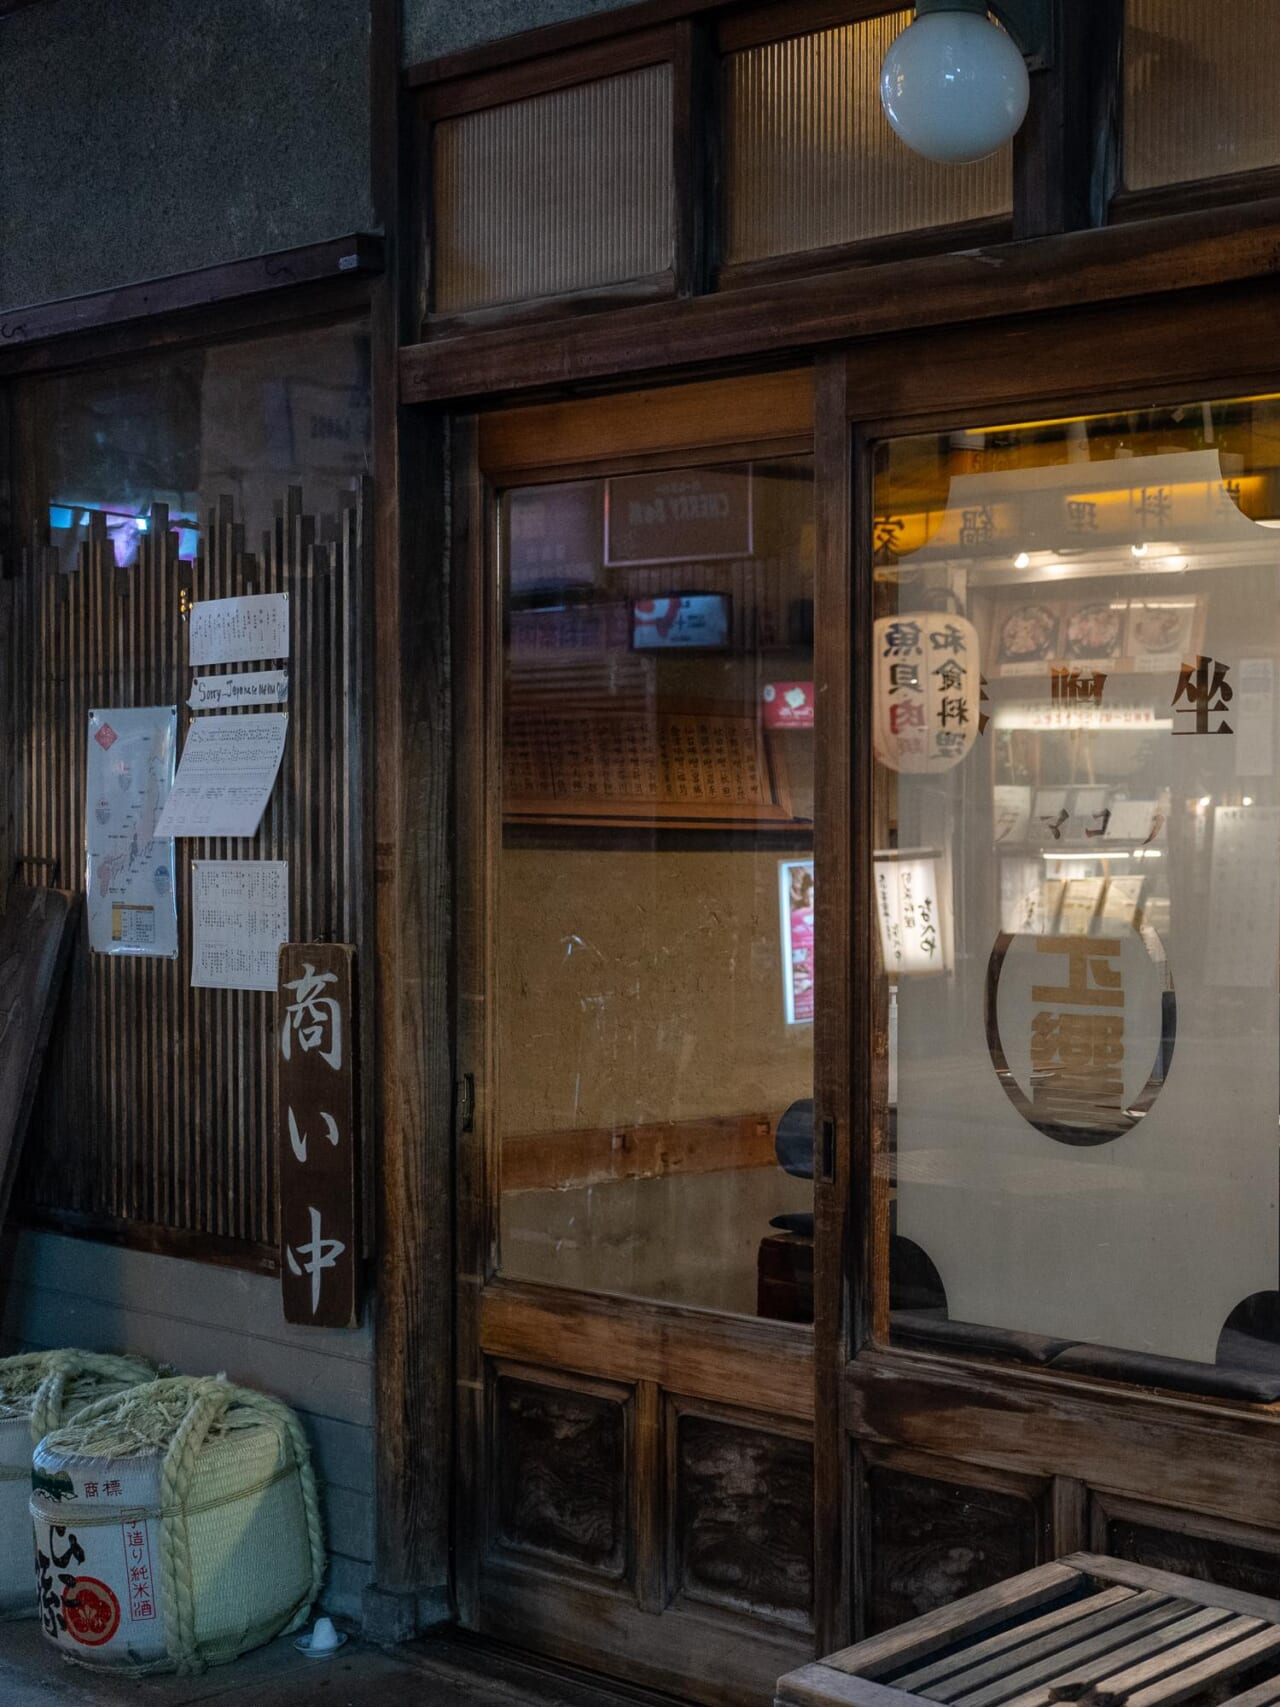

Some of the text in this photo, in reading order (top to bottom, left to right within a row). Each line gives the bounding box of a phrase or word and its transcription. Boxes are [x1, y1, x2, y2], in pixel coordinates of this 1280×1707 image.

[281, 963, 346, 1315] 商い中
[84, 1479, 123, 1498] 商標
